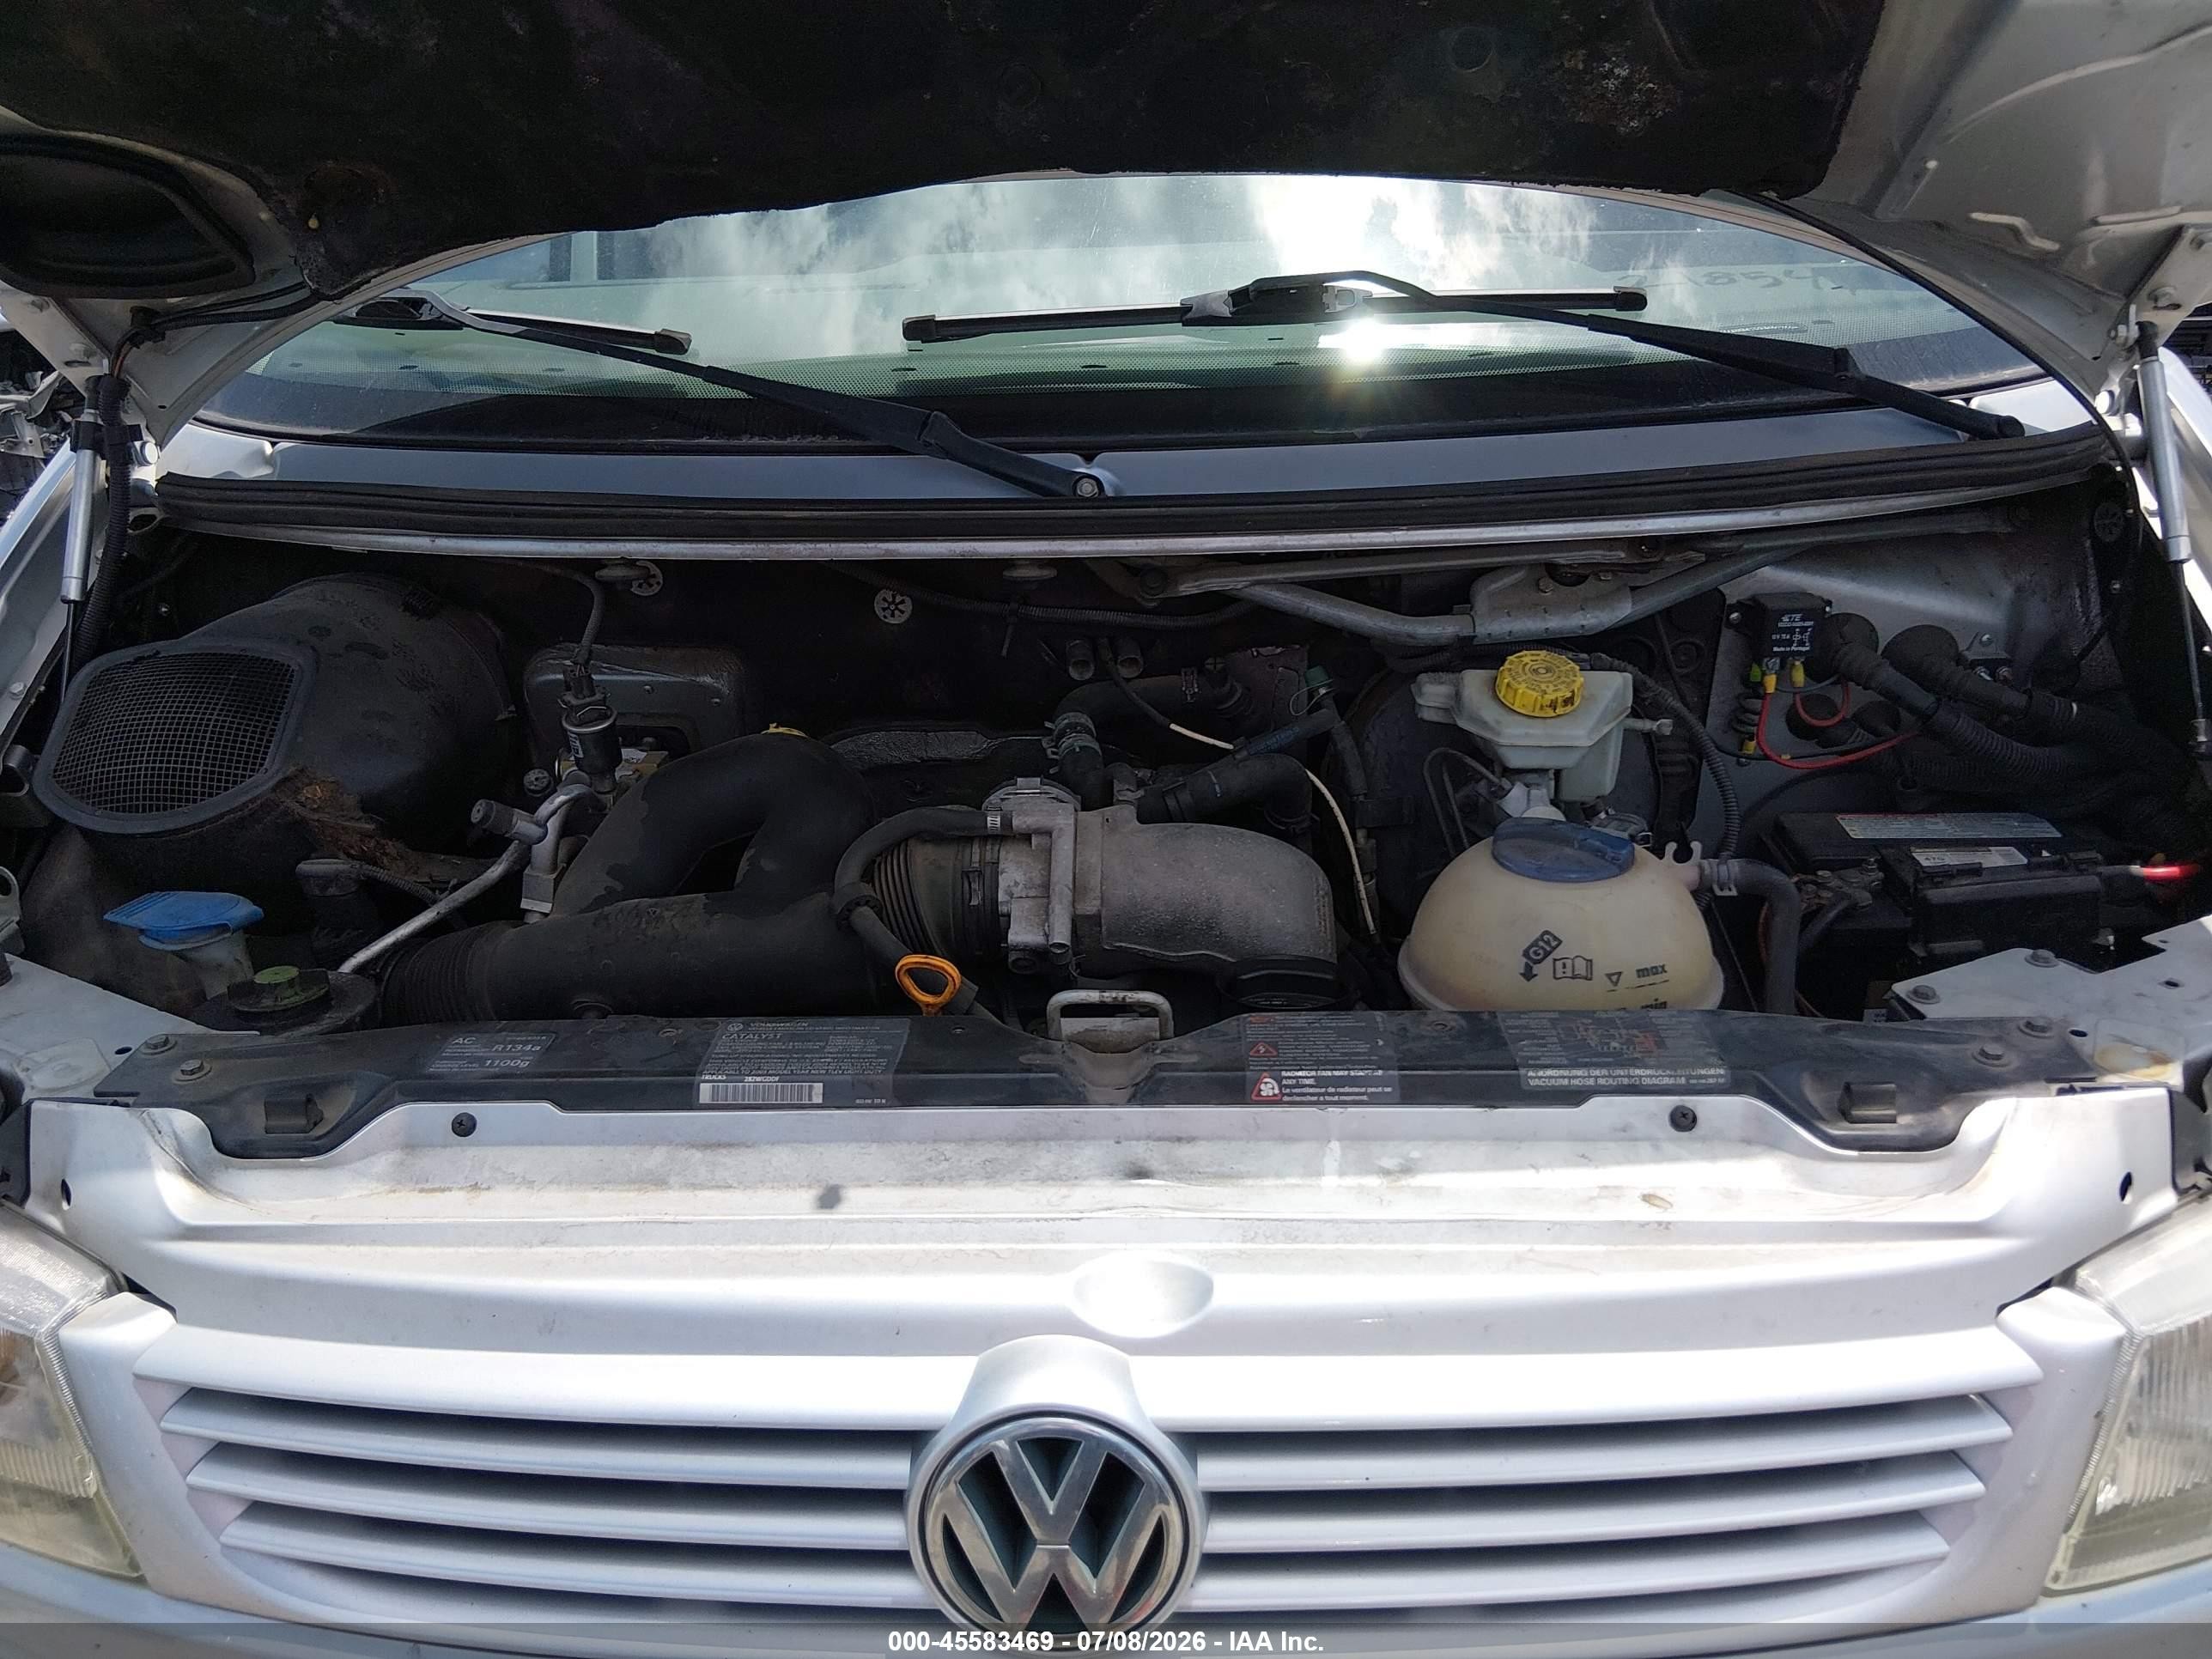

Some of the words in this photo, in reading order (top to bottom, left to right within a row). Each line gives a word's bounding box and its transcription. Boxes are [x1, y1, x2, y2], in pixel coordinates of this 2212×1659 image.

[1529, 933, 1557, 960] G12
[1635, 964, 1668, 979] max
[484, 1060, 531, 1068] 1100g
[1528, 1078, 1568, 1086] VACUUM
[1570, 1078, 1595, 1086] HOSE
[1596, 1077, 1640, 1085] ROUTING
[1641, 1077, 1686, 1085] DIAGRAM
